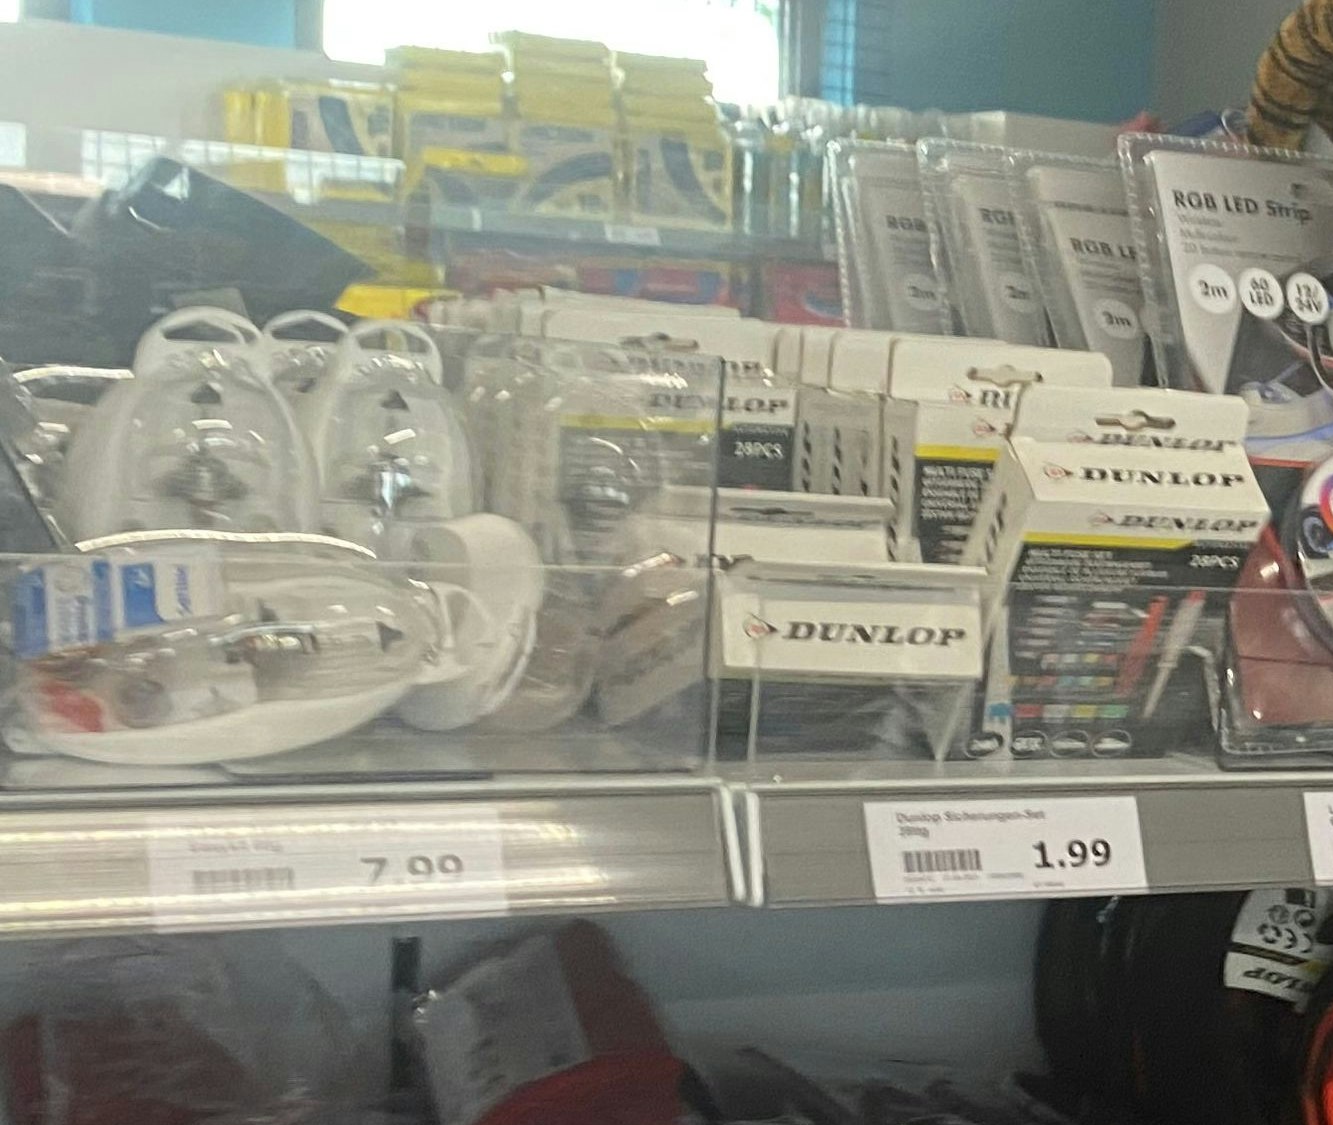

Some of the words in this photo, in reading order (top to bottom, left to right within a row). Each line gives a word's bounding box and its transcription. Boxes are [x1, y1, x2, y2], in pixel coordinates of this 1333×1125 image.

[1223, 195, 1259, 214] LED
[1080, 466, 1245, 488] DUNLOP
[1119, 515, 1259, 532] DUNLOP
[787, 620, 966, 648] DUNLOP
[1033, 837, 1111, 870] 1.99
